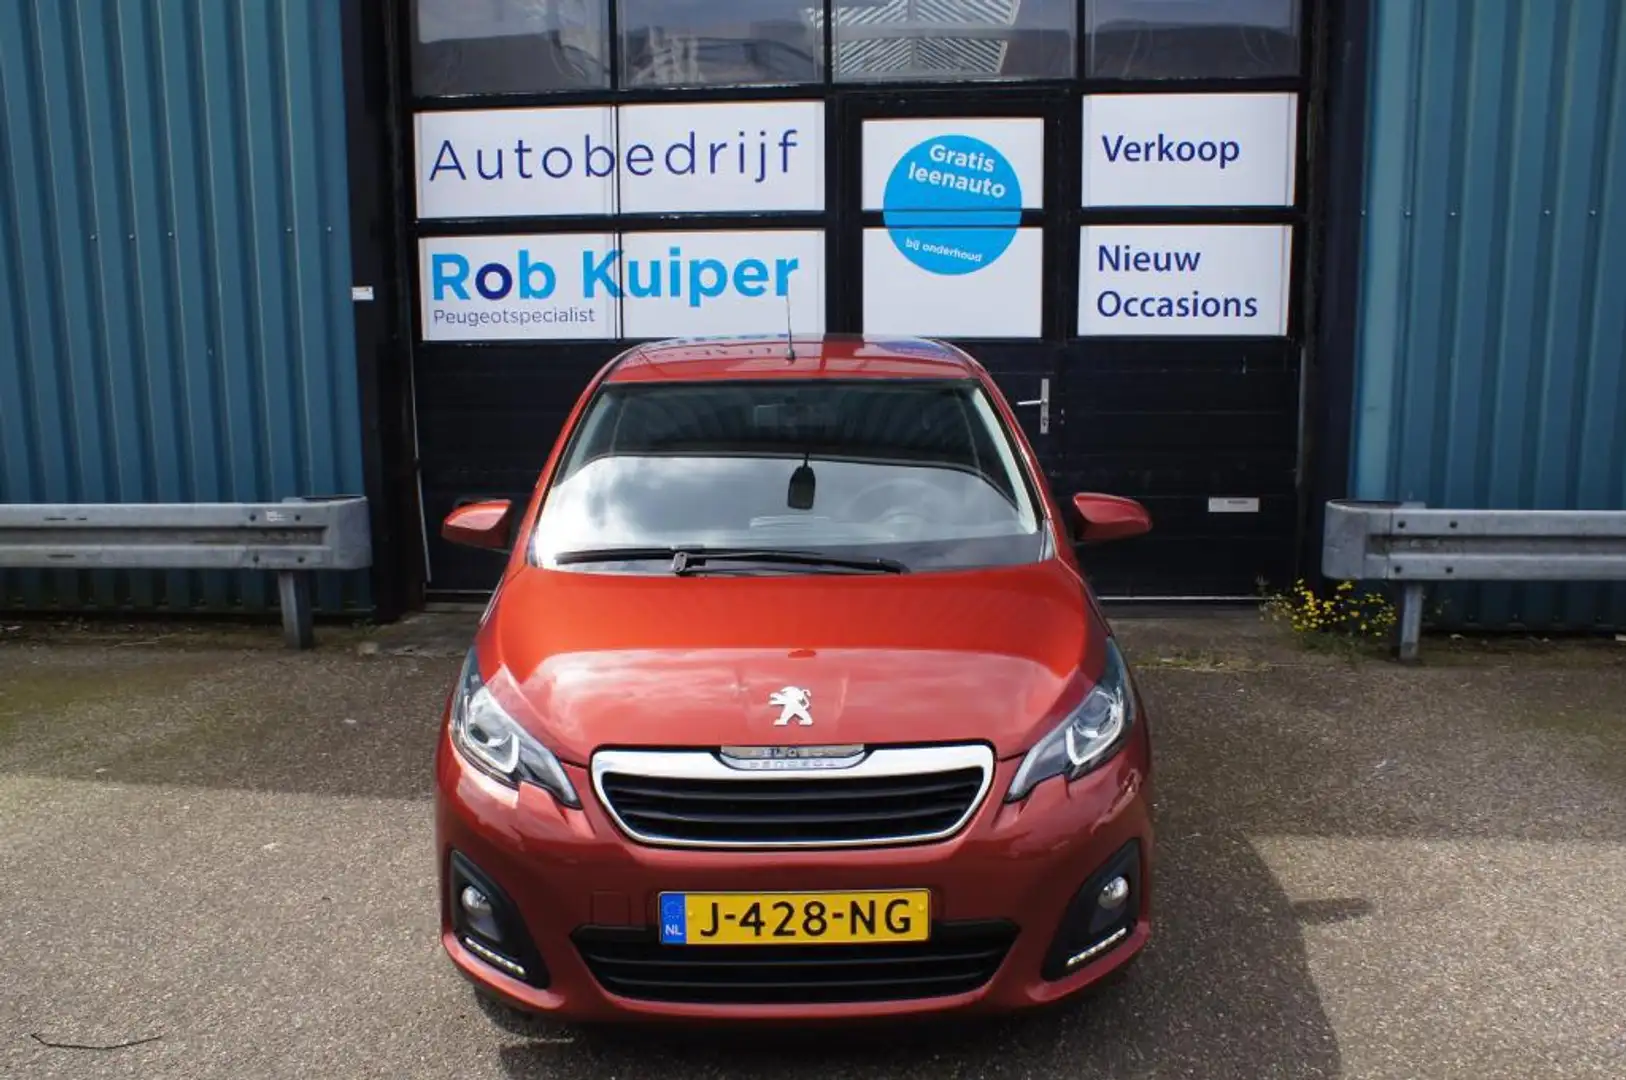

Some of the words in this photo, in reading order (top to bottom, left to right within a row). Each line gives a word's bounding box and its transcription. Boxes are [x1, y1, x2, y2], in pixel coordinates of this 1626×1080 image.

[429, 129, 798, 182] Autobedrijf
[929, 144, 994, 173] Gratis
[1101, 133, 1240, 169] Verkoop
[908, 163, 1006, 199] leenauto
[905, 237, 920, 251] bij
[922, 243, 982, 263] onderhoud
[1098, 244, 1201, 272] Nieuw
[432, 249, 556, 300] Rob
[582, 246, 799, 307] Kuiper
[434, 307, 595, 327] Peugeotspecialist
[1097, 290, 1258, 319] Occasions
[665, 924, 683, 936] NL
[700, 898, 911, 937] J-428-NG
